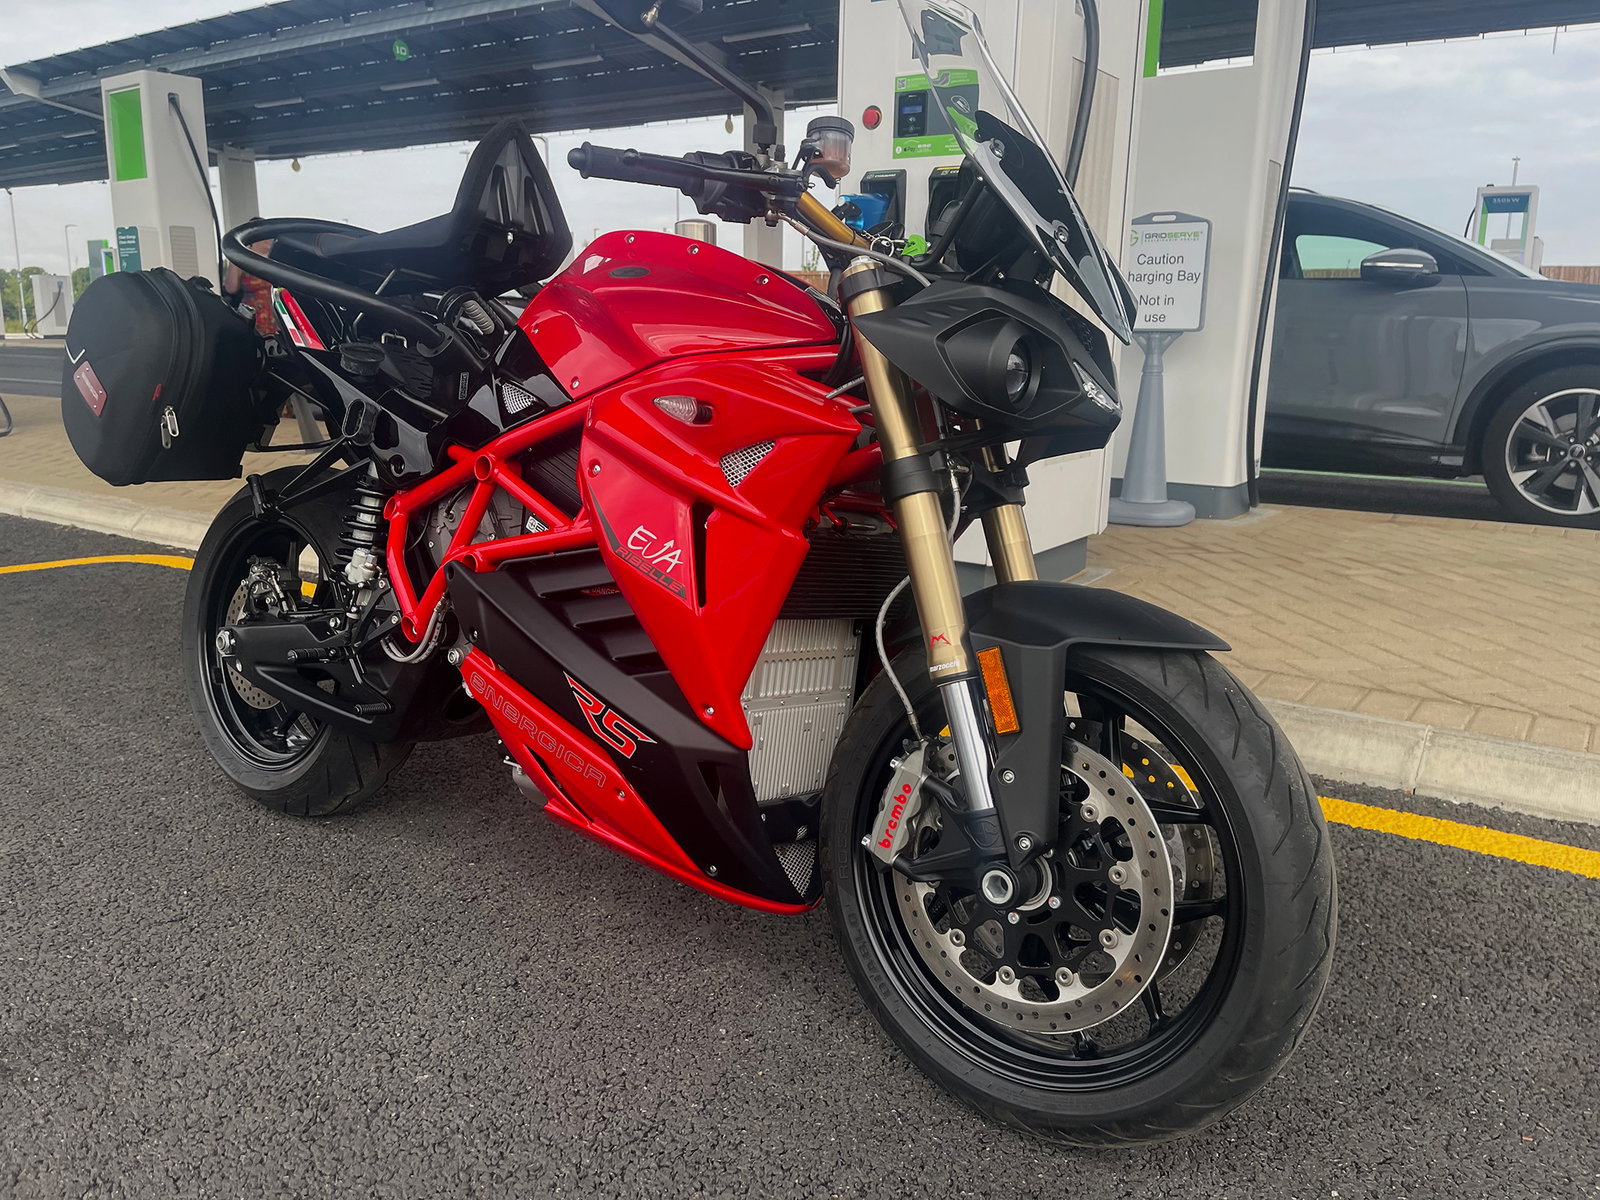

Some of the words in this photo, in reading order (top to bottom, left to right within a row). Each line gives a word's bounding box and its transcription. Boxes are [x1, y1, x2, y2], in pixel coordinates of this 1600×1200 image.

[1144, 231, 1200, 239] GRIDSERVE
[1137, 253, 1184, 265] Caution
[1127, 271, 1173, 284] harging
[1177, 269, 1201, 284] Bay
[1139, 294, 1160, 306] Not
[1163, 294, 1175, 306] in
[1144, 313, 1166, 323] use
[615, 546, 685, 593] RIBELLE
[562, 670, 658, 759] RS
[877, 783, 912, 850] brembo
